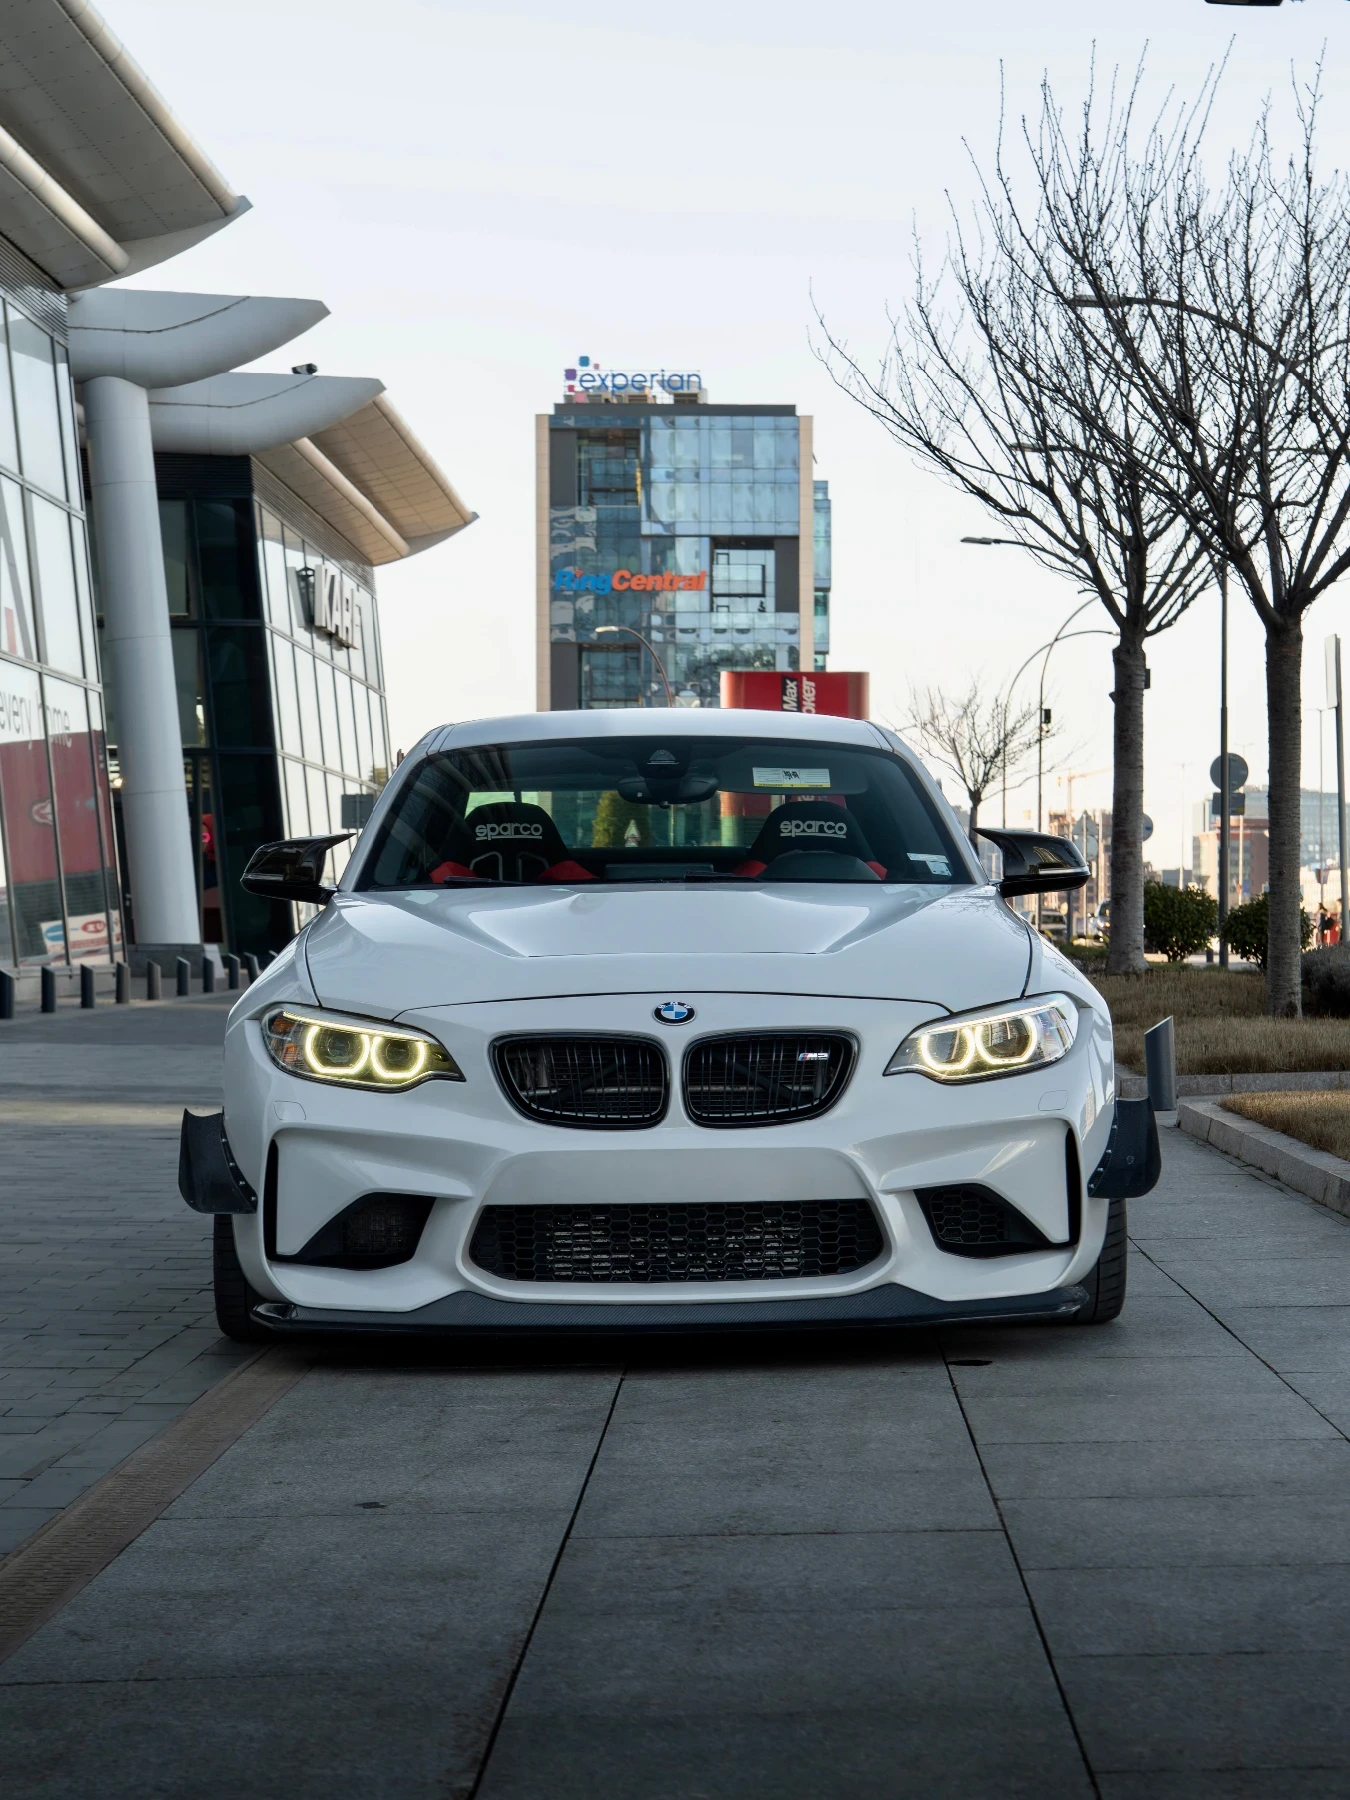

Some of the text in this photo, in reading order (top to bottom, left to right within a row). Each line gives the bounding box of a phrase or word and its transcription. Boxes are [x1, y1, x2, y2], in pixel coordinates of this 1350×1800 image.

[579, 367, 702, 396] experian
[554, 570, 706, 595] RingCentral
[782, 679, 798, 711] Max
[475, 823, 543, 840] sparco
[780, 820, 848, 837] sparco
